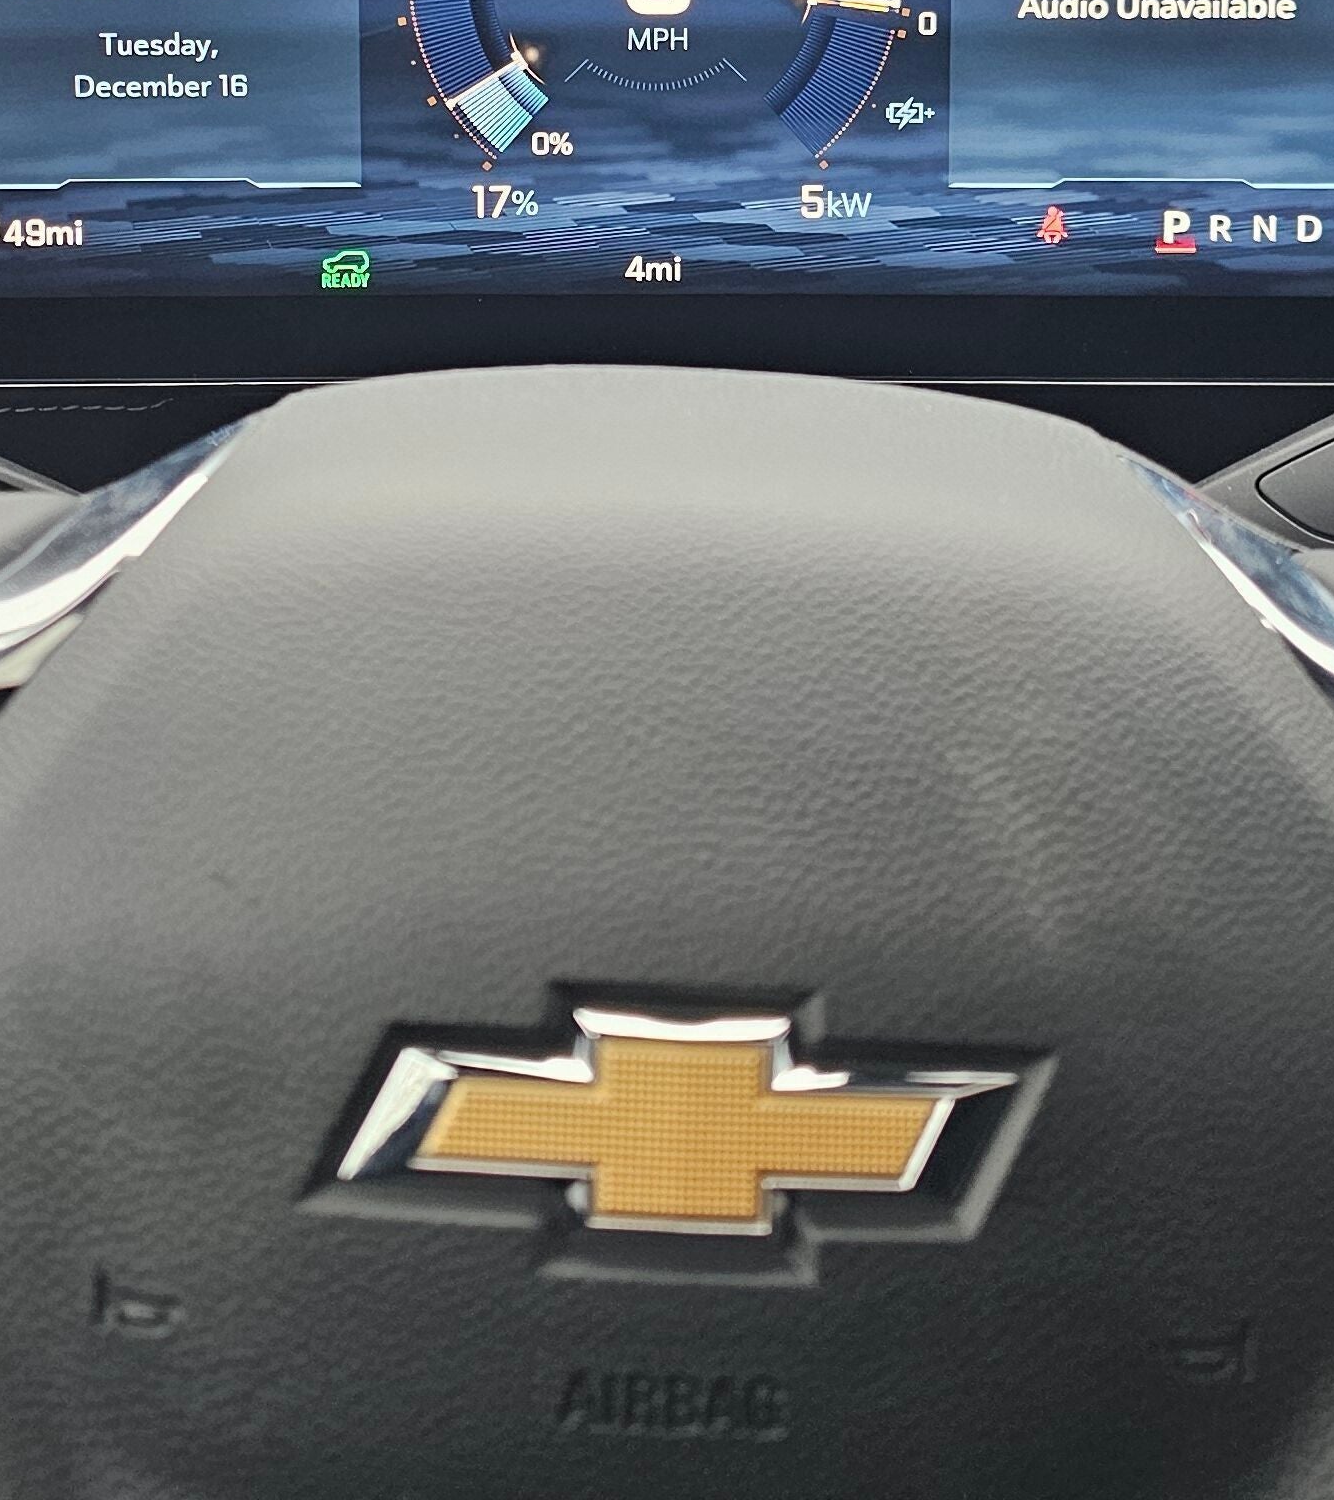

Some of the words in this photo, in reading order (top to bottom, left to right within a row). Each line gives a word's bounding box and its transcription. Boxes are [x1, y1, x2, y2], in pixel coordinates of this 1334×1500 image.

[918, 11, 938, 36] 0
[98, 31, 219, 63] Tuesday,
[627, 27, 688, 51] MPH
[74, 73, 213, 98] December
[218, 74, 248, 97] 16
[531, 131, 574, 156] 0%
[472, 185, 539, 220] 17%
[800, 185, 872, 220] 5kW
[2, 218, 83, 247] 49mi
[1163, 210, 1191, 244] P
[1209, 214, 1233, 243] R
[1252, 214, 1278, 243] N
[1296, 214, 1323, 243] D
[321, 272, 370, 288] READY
[624, 256, 683, 282] 4mi
